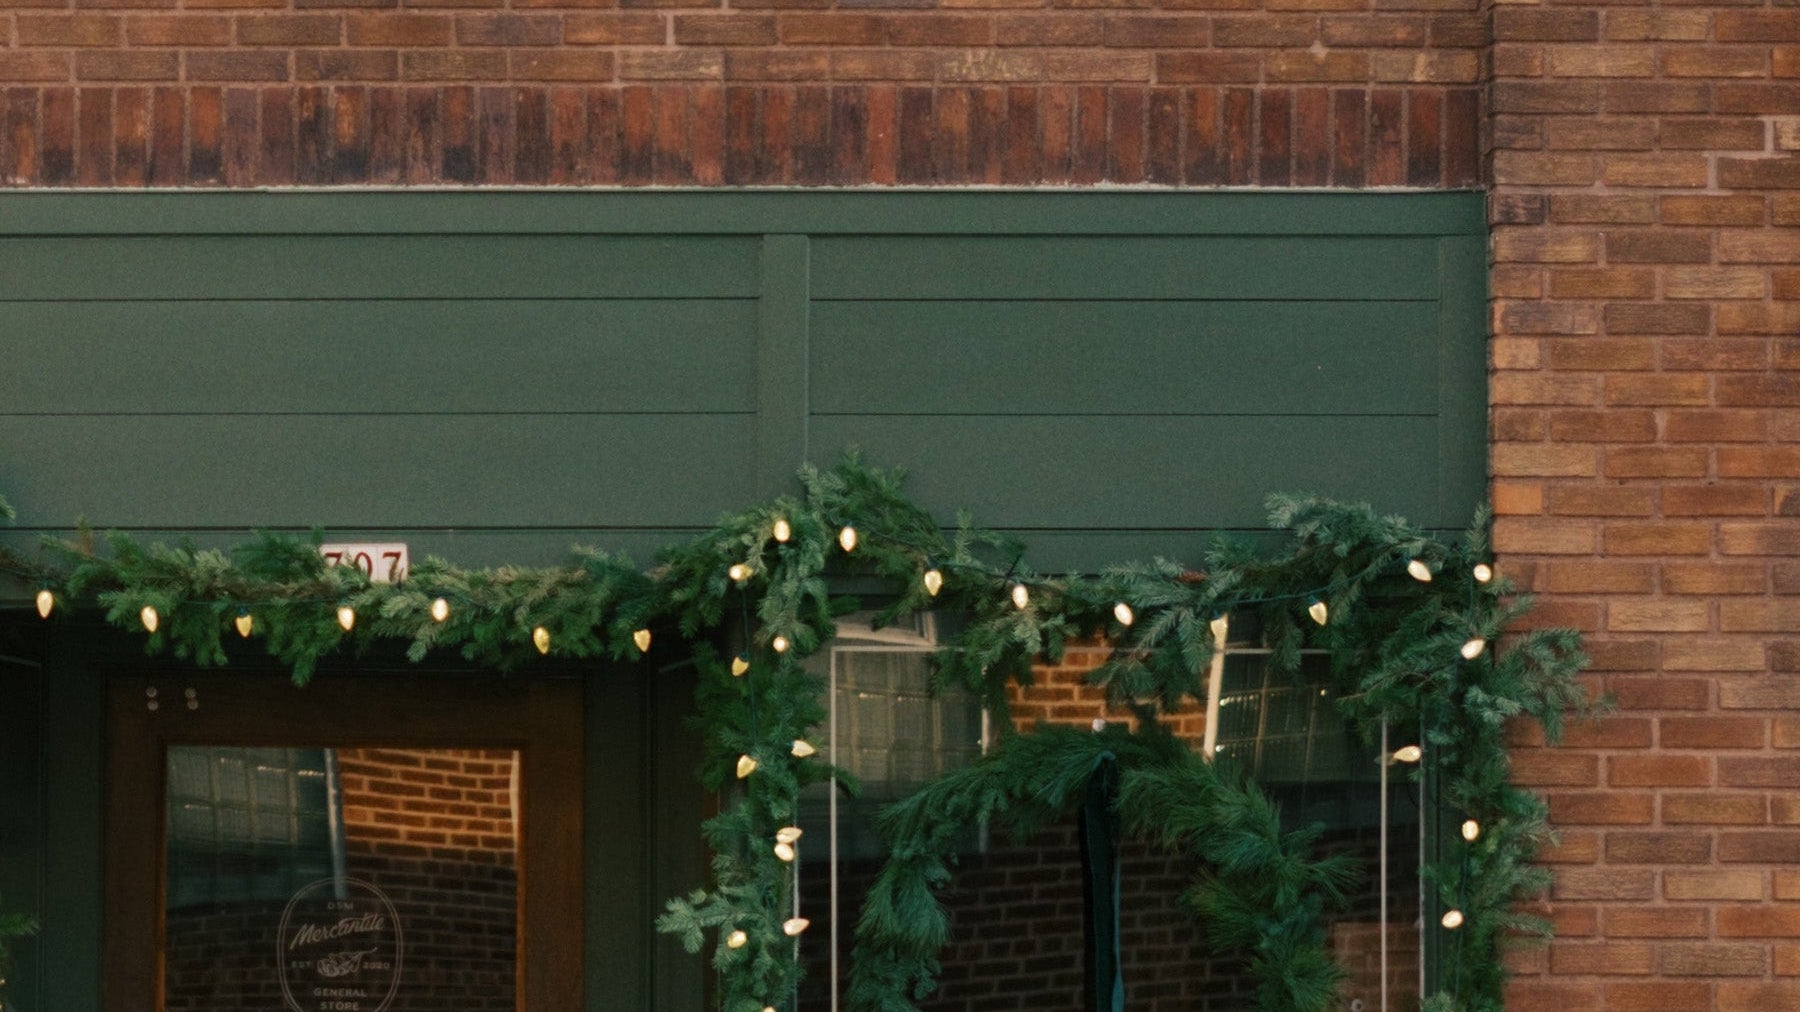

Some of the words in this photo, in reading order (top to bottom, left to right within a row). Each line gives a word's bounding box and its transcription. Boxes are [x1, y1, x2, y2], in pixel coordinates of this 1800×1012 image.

[327, 902, 354, 911] DSM
[289, 912, 385, 950] Mercantile
[291, 960, 311, 969] EST
[362, 961, 391, 970] 2020
[313, 987, 368, 998] GENERAL
[320, 1001, 360, 1012] STORE
